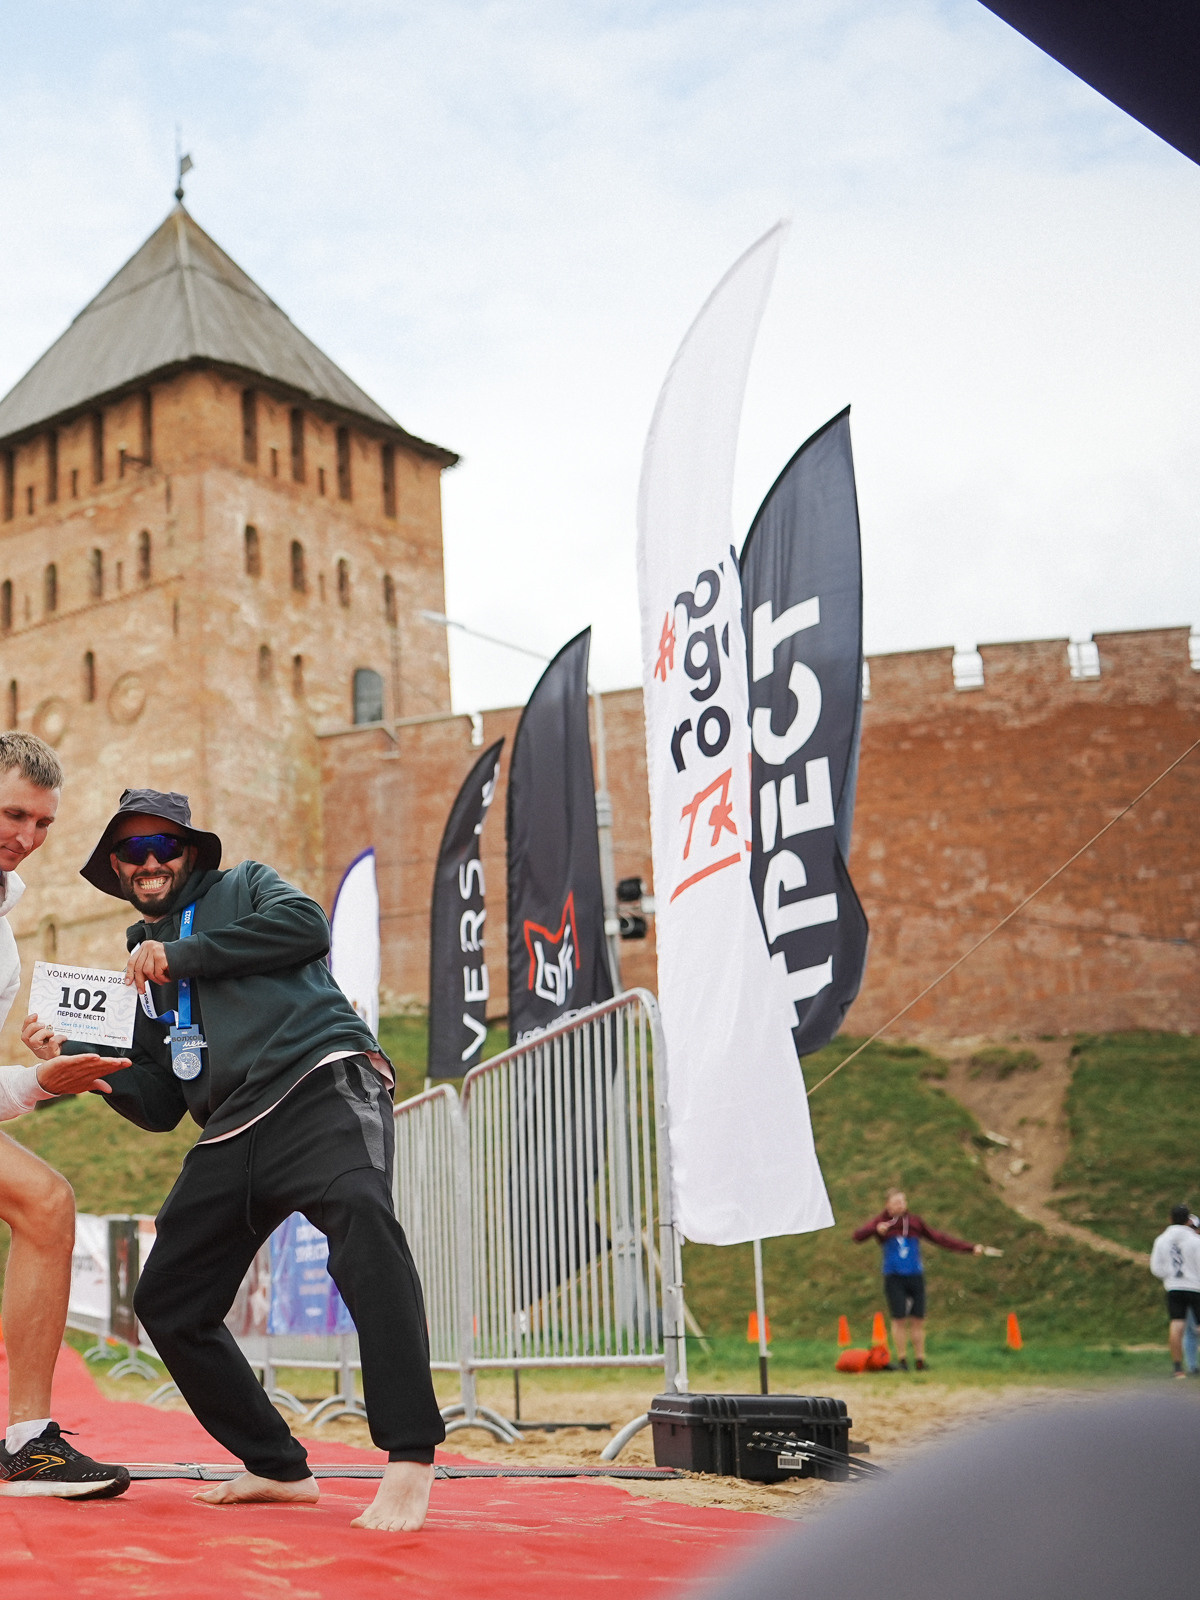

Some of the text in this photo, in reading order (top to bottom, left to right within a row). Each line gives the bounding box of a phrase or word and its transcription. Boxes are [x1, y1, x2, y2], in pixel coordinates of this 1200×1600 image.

[184, 910, 192, 925] 2023
[47, 969, 106, 983] VOLKHOVMAN
[58, 986, 107, 1013] 102
[57, 1010, 105, 1021] ПЕРВОЕ МЕСТО
